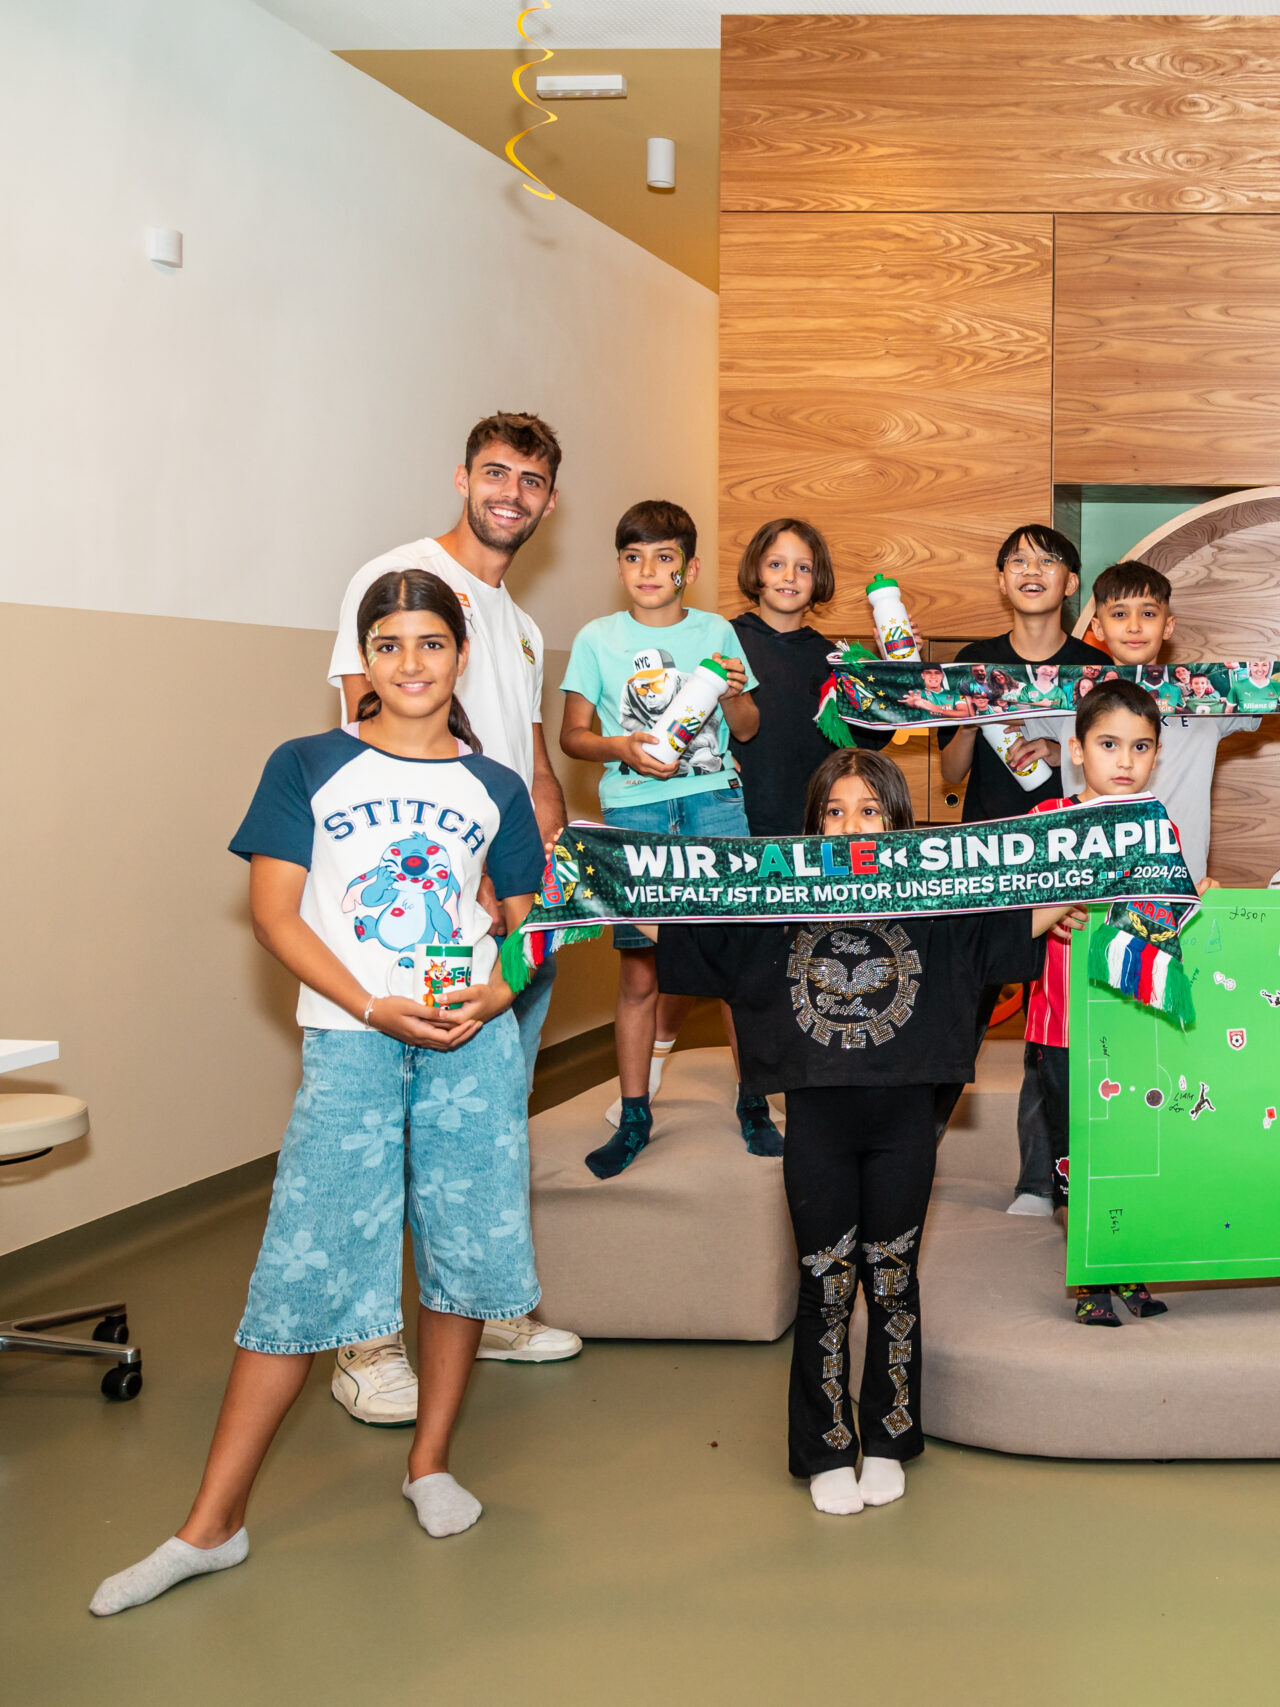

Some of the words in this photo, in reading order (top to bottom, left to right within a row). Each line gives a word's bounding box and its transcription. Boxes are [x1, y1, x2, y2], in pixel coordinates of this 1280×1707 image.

[885, 637, 914, 651] RAPID
[634, 656, 651, 671] NYC
[323, 798, 486, 856] STITCH
[623, 844, 720, 878] WIR
[919, 833, 1035, 871] SIND
[1047, 819, 1182, 863] RAPID
[624, 885, 723, 903] VIELFALT
[727, 886, 762, 903] IST
[766, 885, 809, 903] DER
[814, 882, 893, 902] MOTOR
[896, 876, 995, 898] UNSERES
[1000, 869, 1094, 892] ERFOLGS
[1133, 866, 1188, 879] 2024/25
